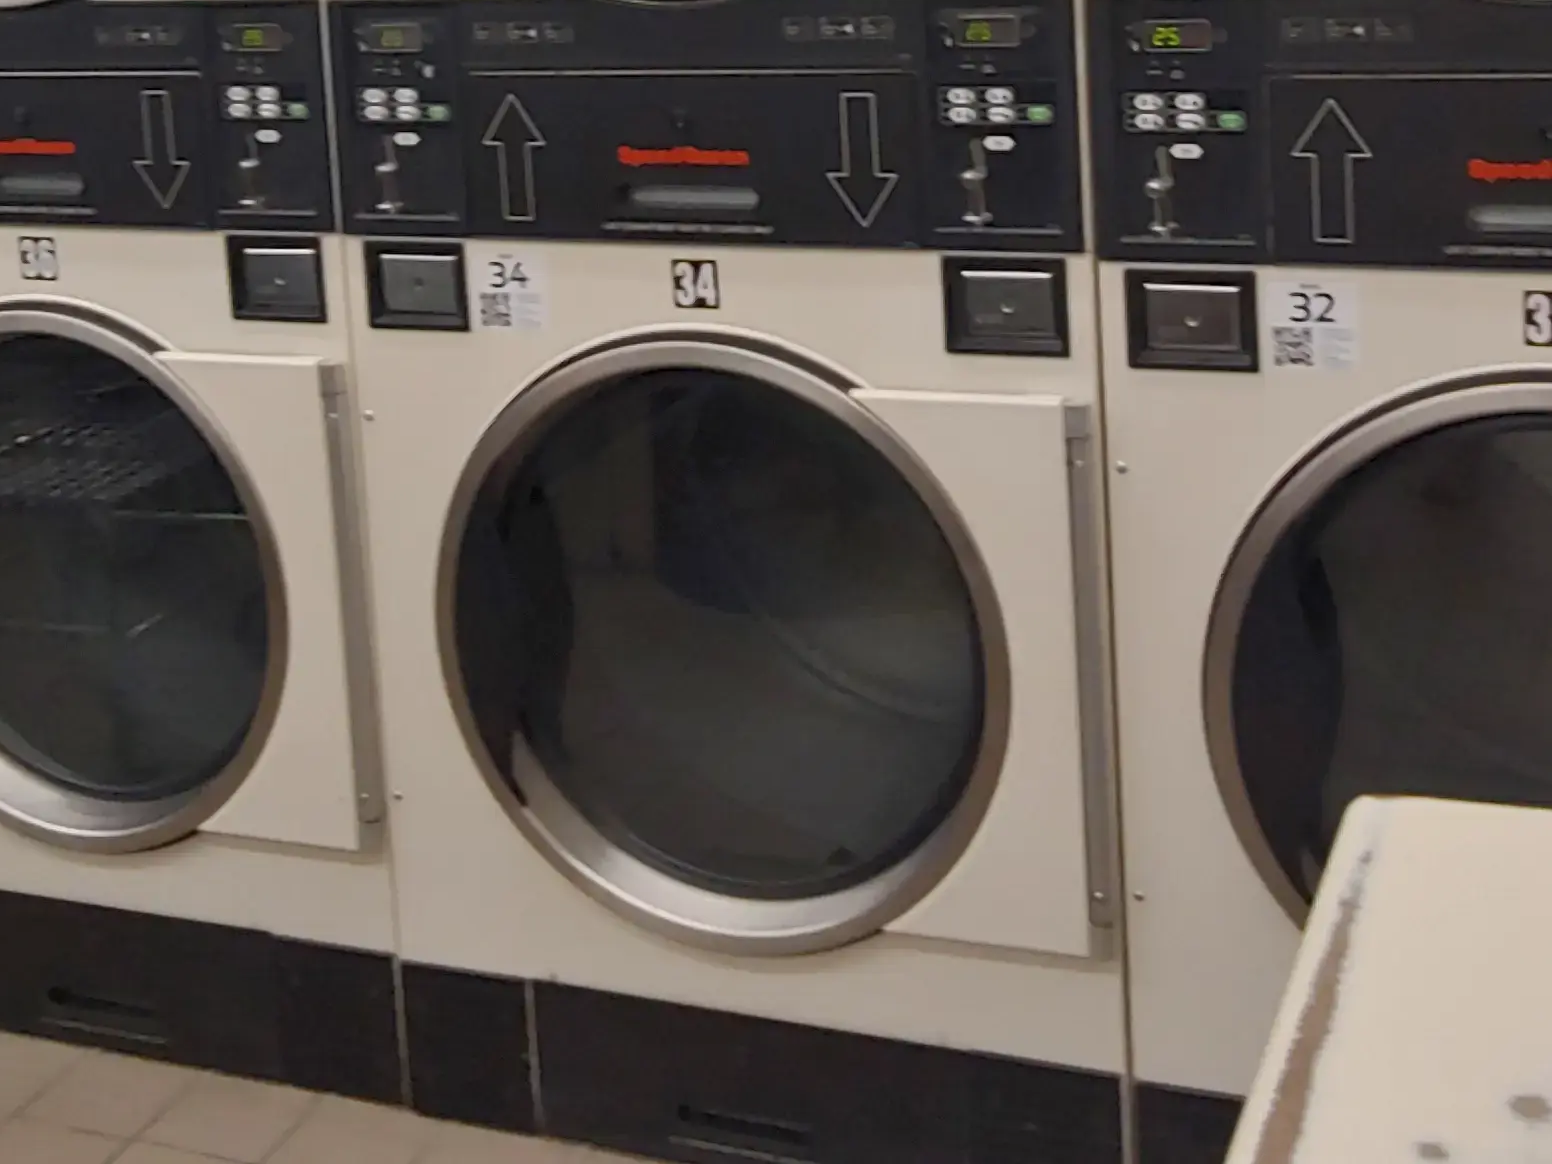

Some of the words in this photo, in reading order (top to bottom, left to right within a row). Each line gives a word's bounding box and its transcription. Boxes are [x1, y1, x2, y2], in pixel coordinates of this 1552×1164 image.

[488, 260, 531, 289] 34
[673, 261, 719, 307] 34
[1288, 291, 1336, 323] 32
